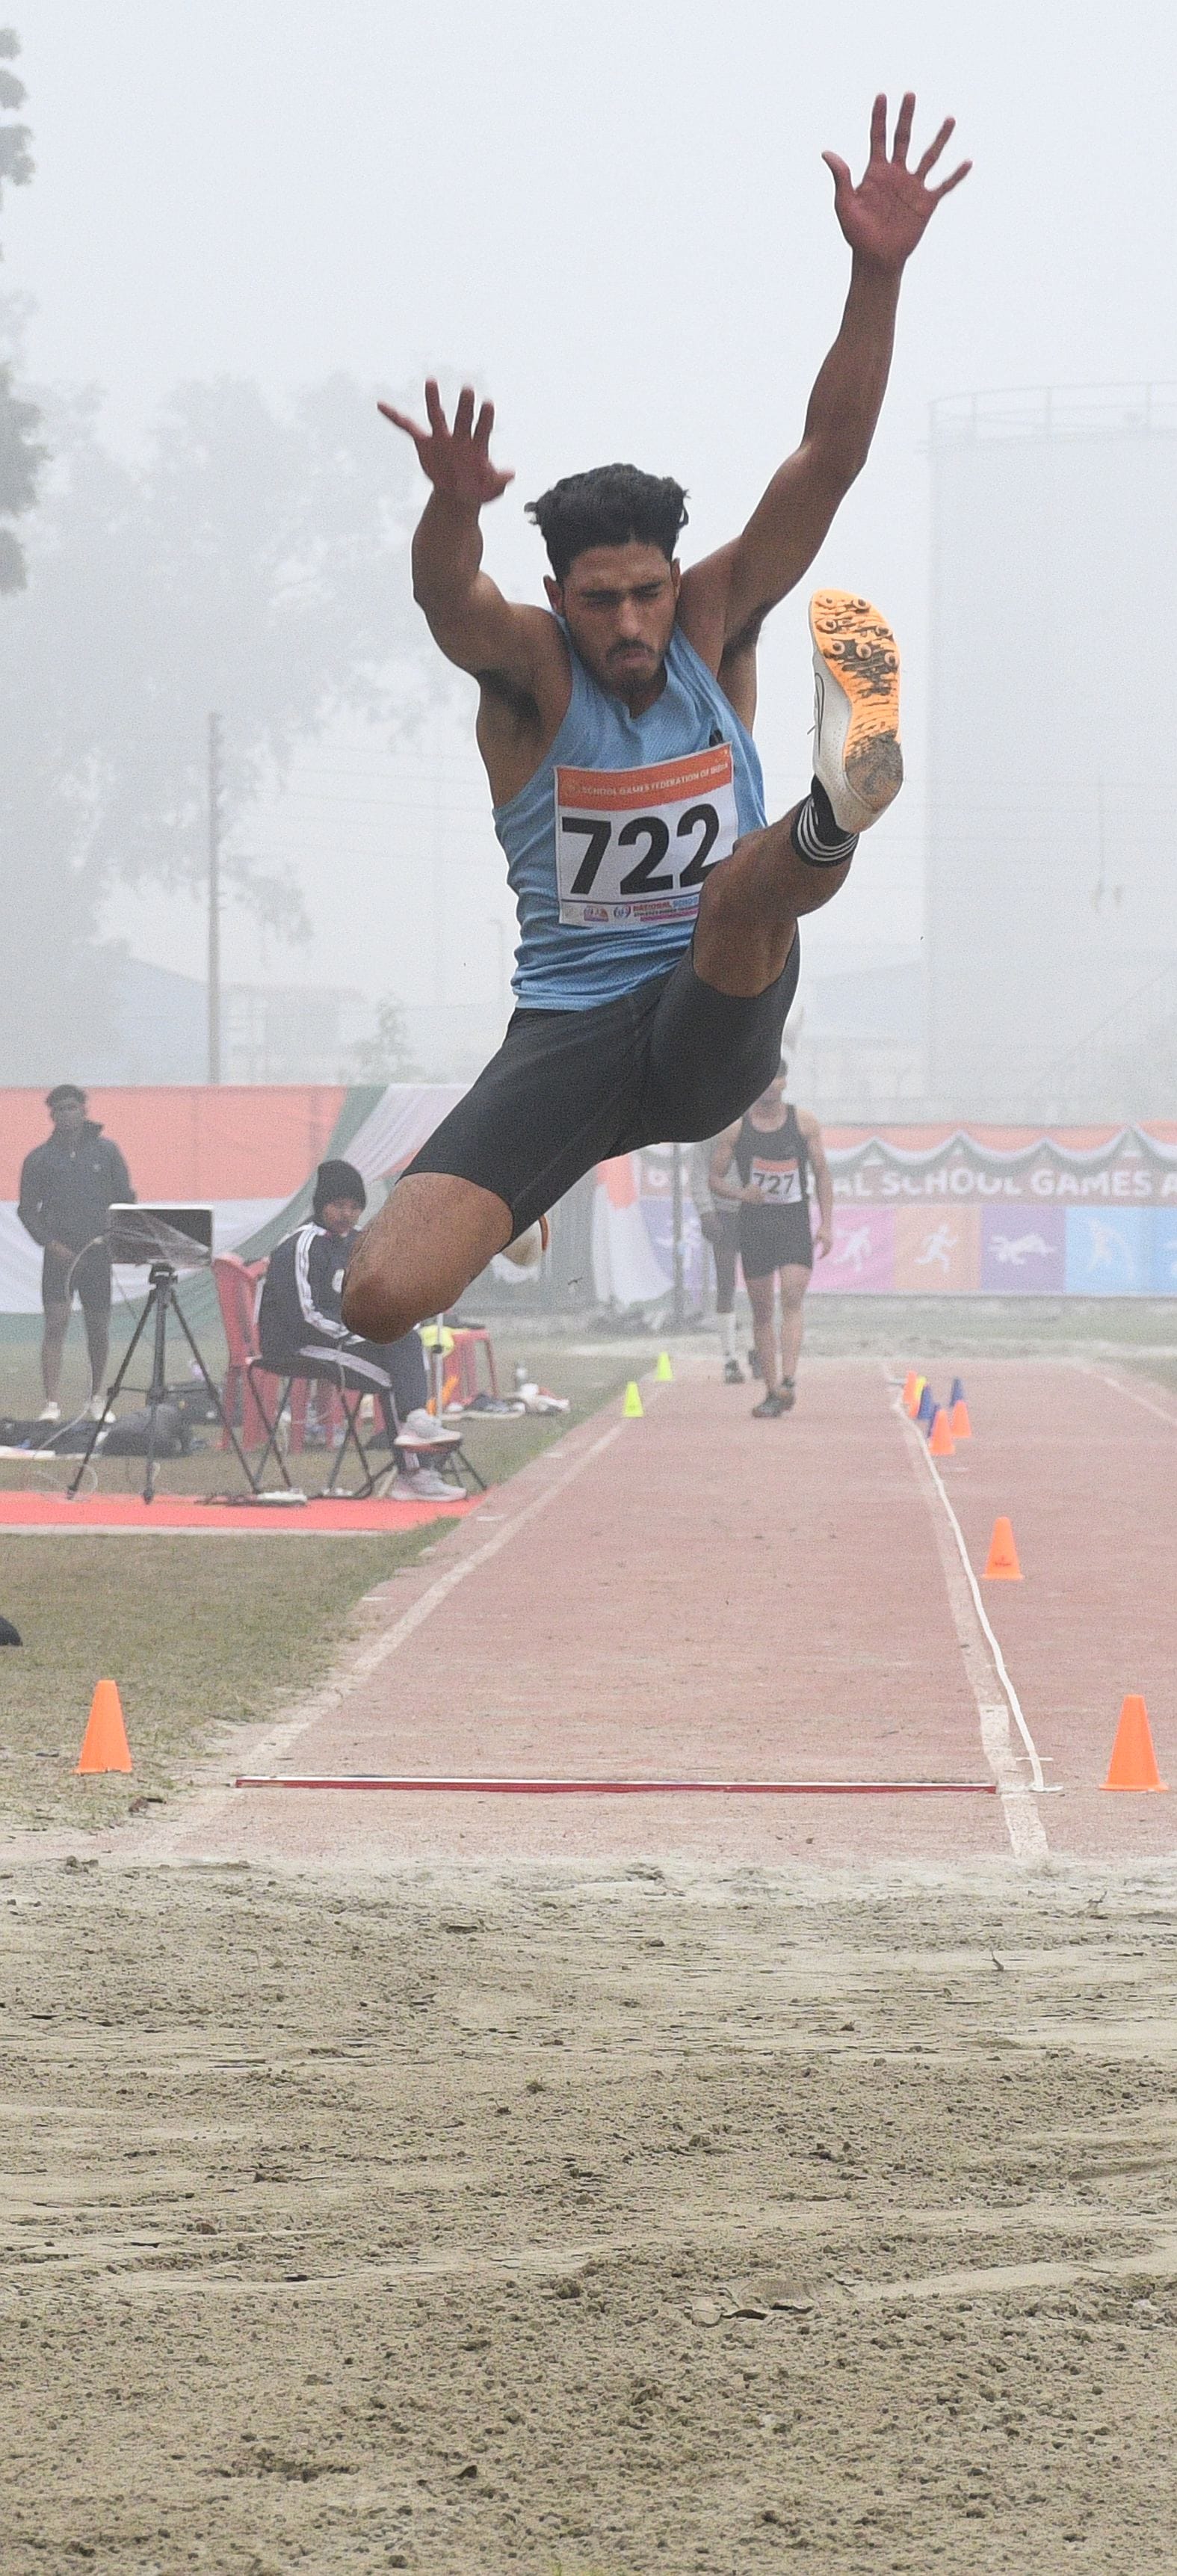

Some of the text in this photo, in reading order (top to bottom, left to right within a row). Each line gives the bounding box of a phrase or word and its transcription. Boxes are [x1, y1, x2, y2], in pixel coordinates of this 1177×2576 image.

[650, 774, 699, 791] FEDERATION
[561, 803, 720, 895] 722
[753, 1171, 794, 1195] 727
[1031, 1168, 1152, 1196] GAMES
